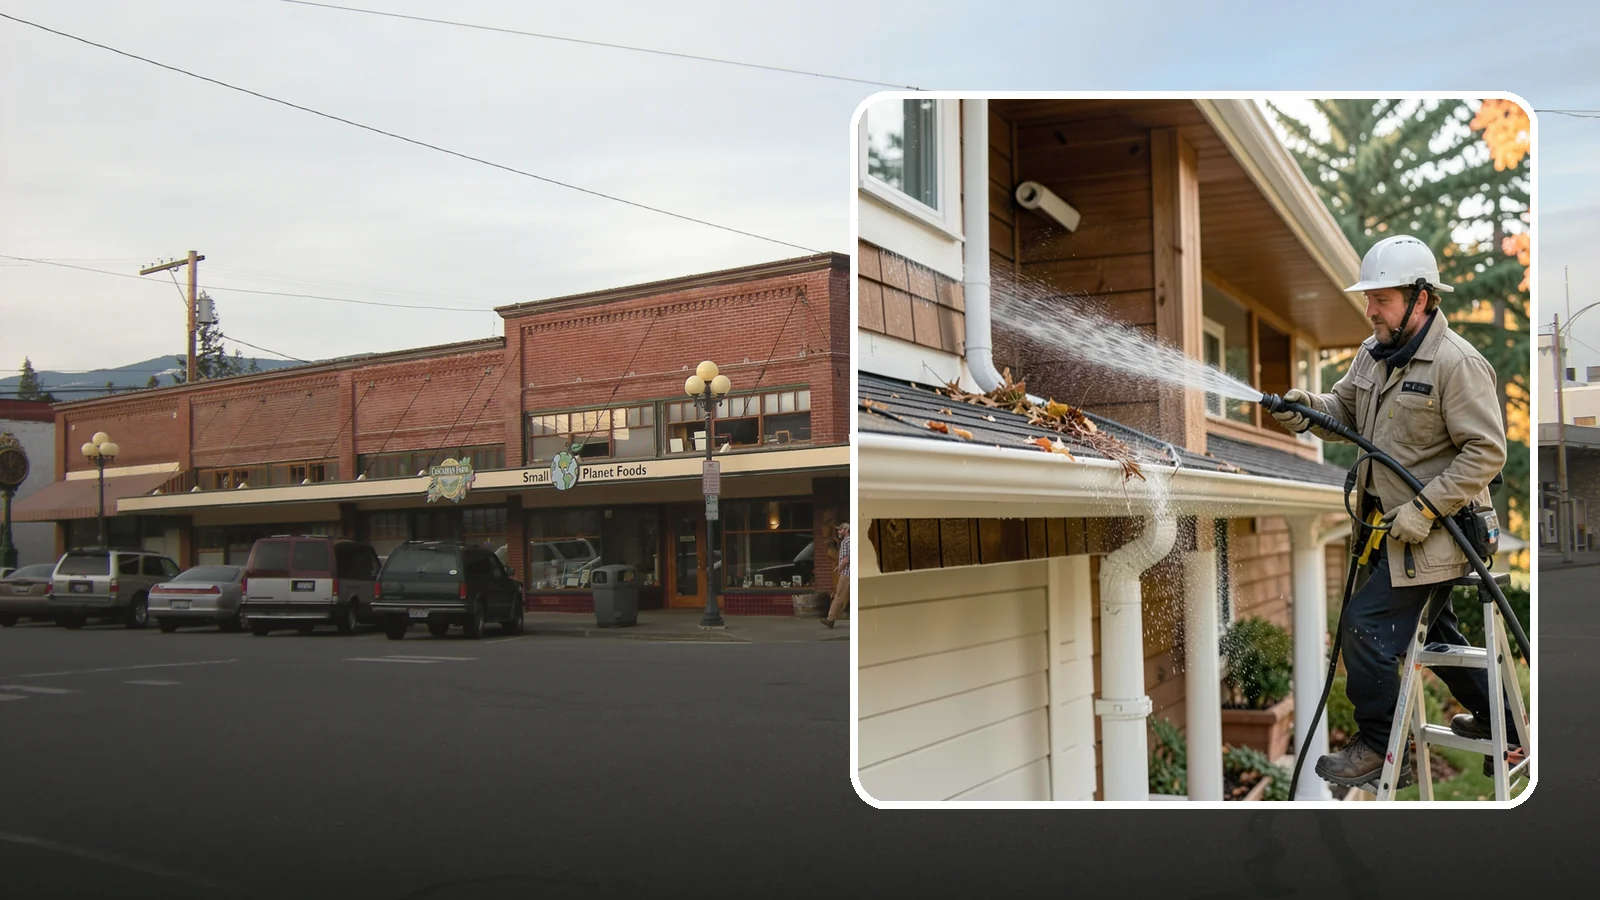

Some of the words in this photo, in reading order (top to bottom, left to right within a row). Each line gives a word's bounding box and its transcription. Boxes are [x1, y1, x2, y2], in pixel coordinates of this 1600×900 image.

[523, 471, 549, 483] Small
[582, 468, 614, 479] Planet
[617, 464, 647, 476] Foods
